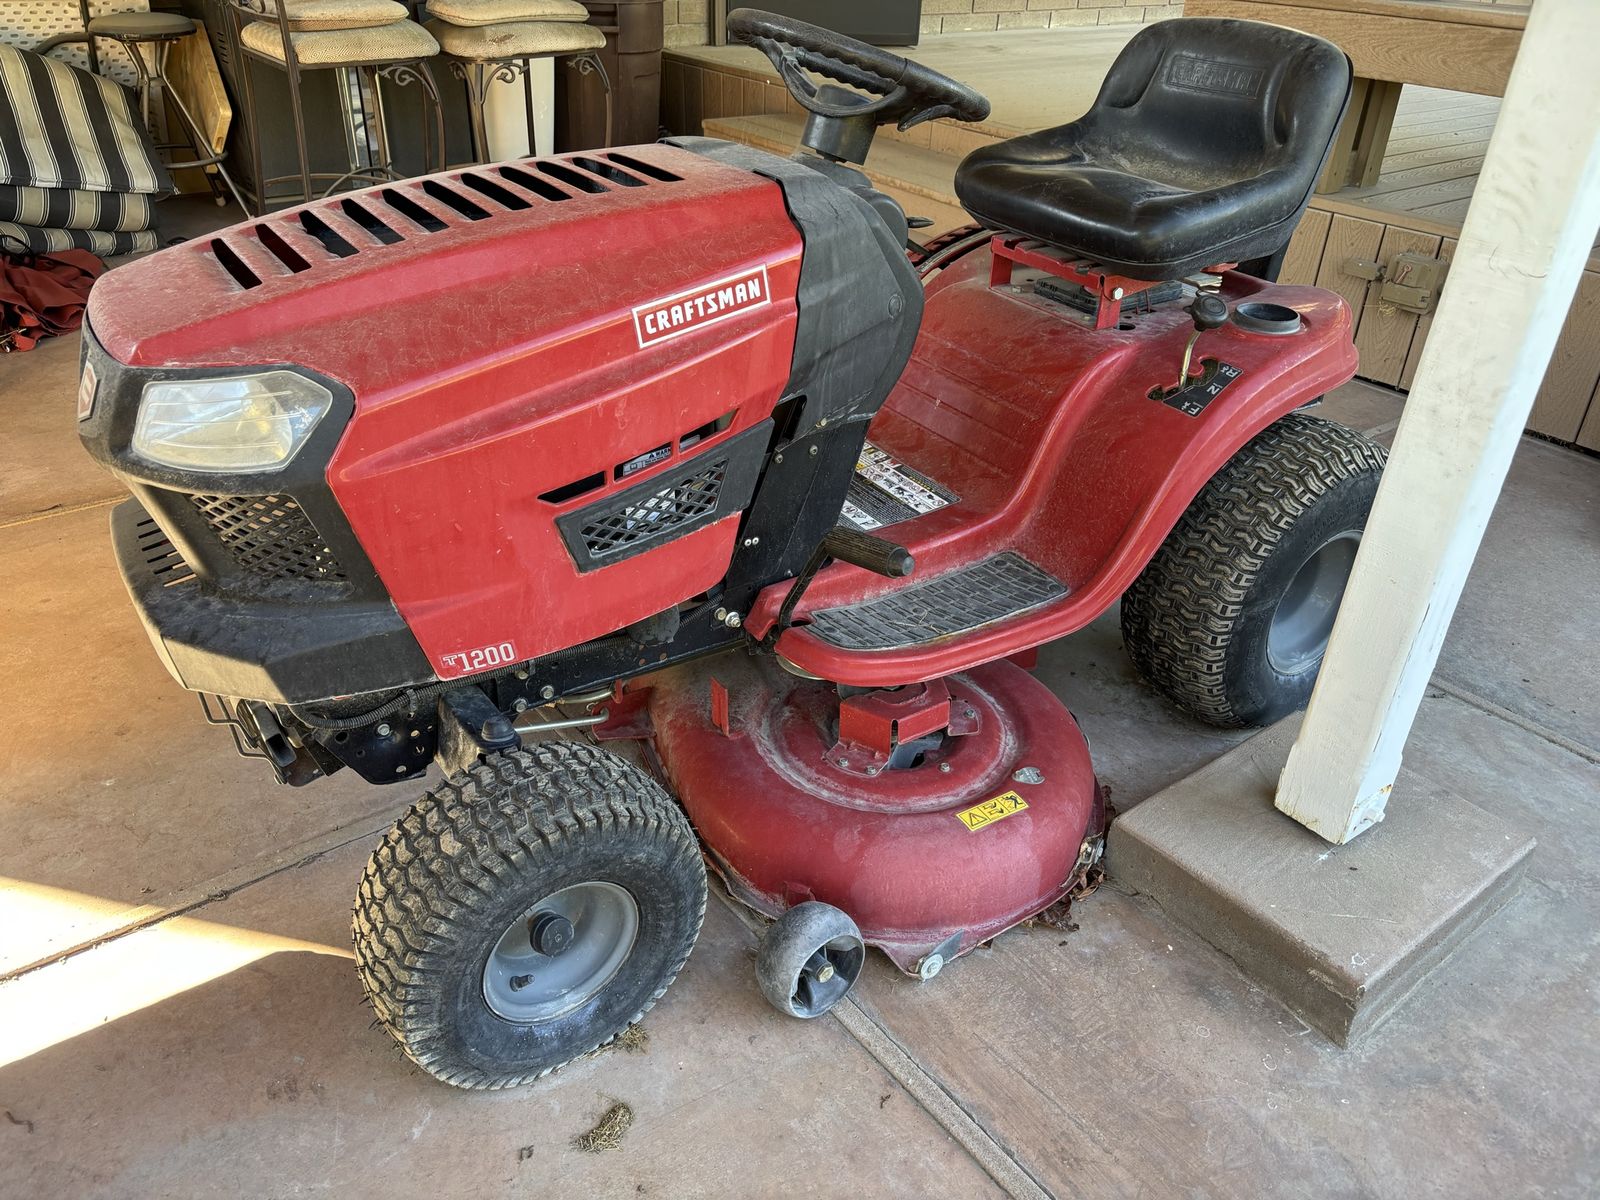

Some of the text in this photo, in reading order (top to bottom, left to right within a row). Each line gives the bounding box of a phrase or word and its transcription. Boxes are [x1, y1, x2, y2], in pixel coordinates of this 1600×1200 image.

[644, 278, 761, 335] CRAFTSMAN
[1226, 369, 1239, 378] R
[1207, 385, 1220, 395] N
[1188, 407, 1200, 415] F
